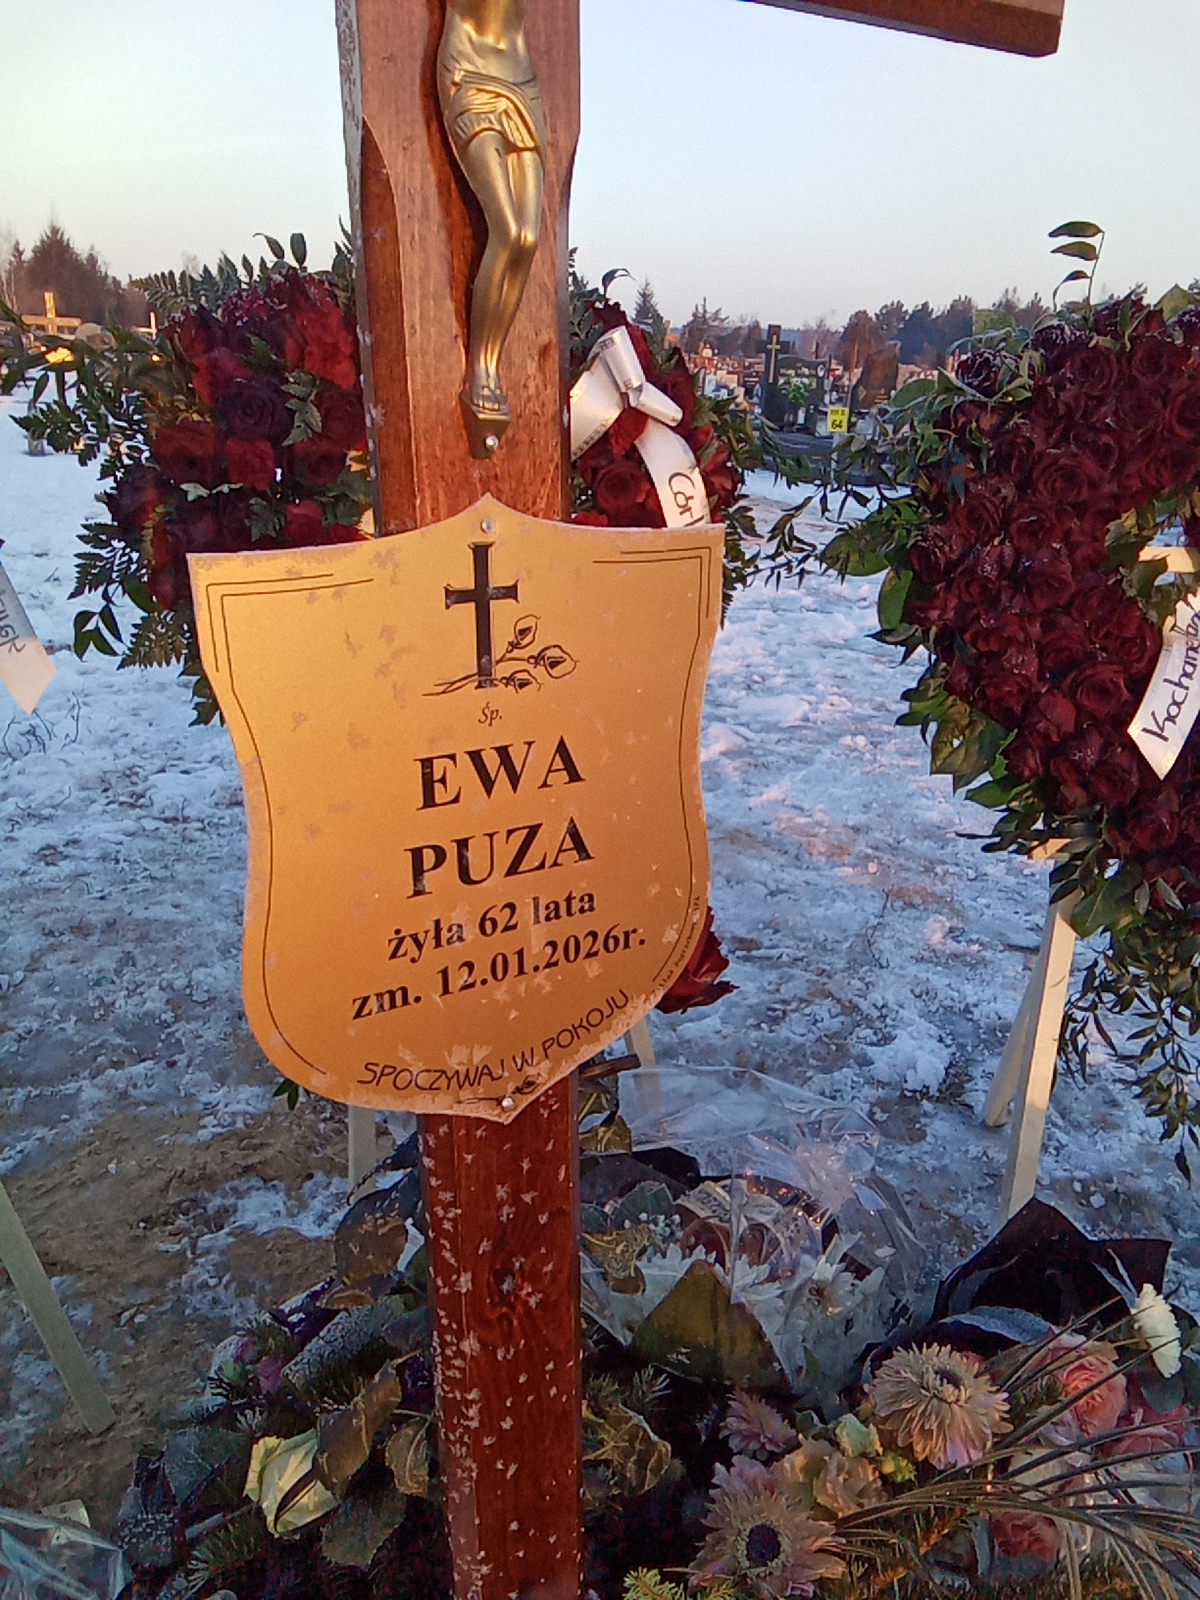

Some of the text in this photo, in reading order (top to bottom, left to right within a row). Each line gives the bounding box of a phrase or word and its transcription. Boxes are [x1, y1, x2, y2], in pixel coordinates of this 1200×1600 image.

[413, 734, 587, 811] EWA
[403, 815, 596, 900] PUZA
[387, 890, 597, 964] żyła 62 lata
[352, 984, 423, 1021] zm.
[435, 923, 646, 998] 12.01.2026r.
[356, 988, 630, 1091] SPOCZYWAJ W POKOJU
